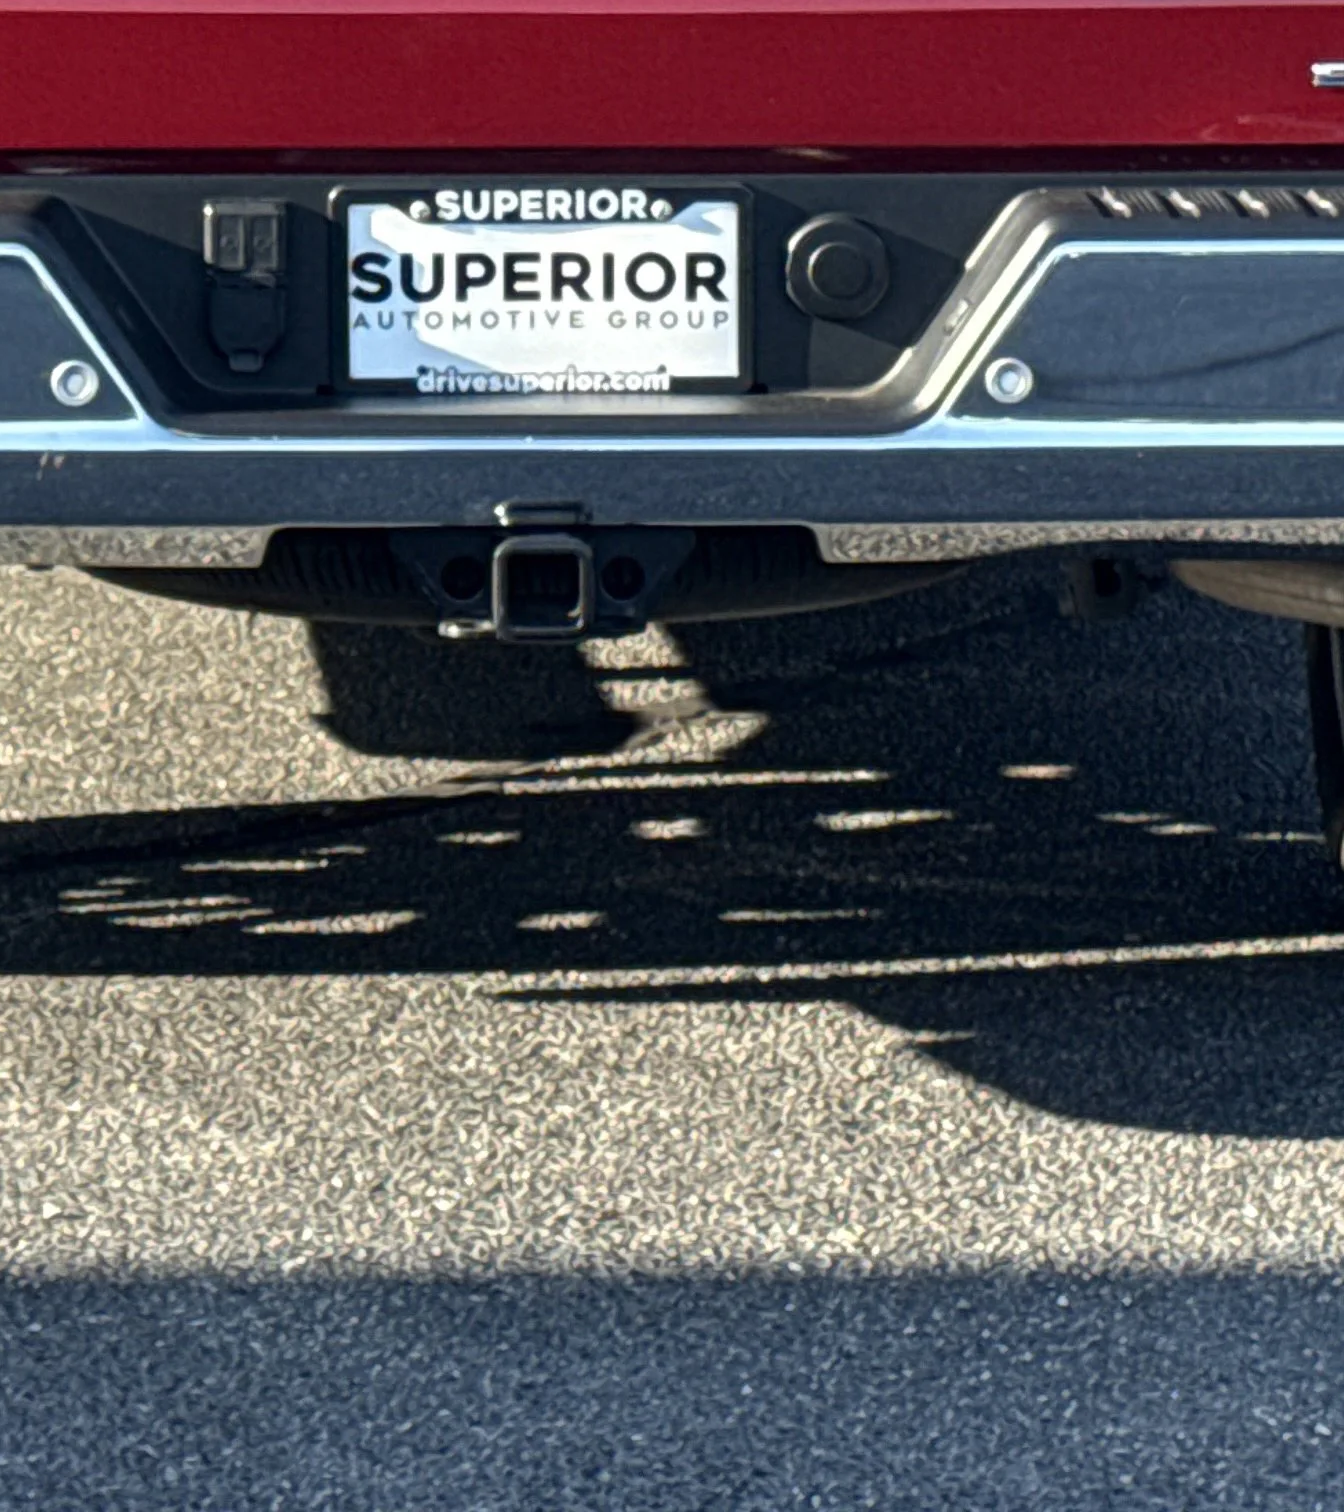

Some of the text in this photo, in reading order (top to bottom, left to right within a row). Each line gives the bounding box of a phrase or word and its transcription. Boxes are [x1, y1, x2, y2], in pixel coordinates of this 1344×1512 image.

[435, 189, 648, 222] SUPERIOR
[350, 251, 730, 304] SUPERIOR
[352, 309, 730, 331] AUTOMOTIVE GROUP
[416, 365, 671, 395] drivesuperior.com
